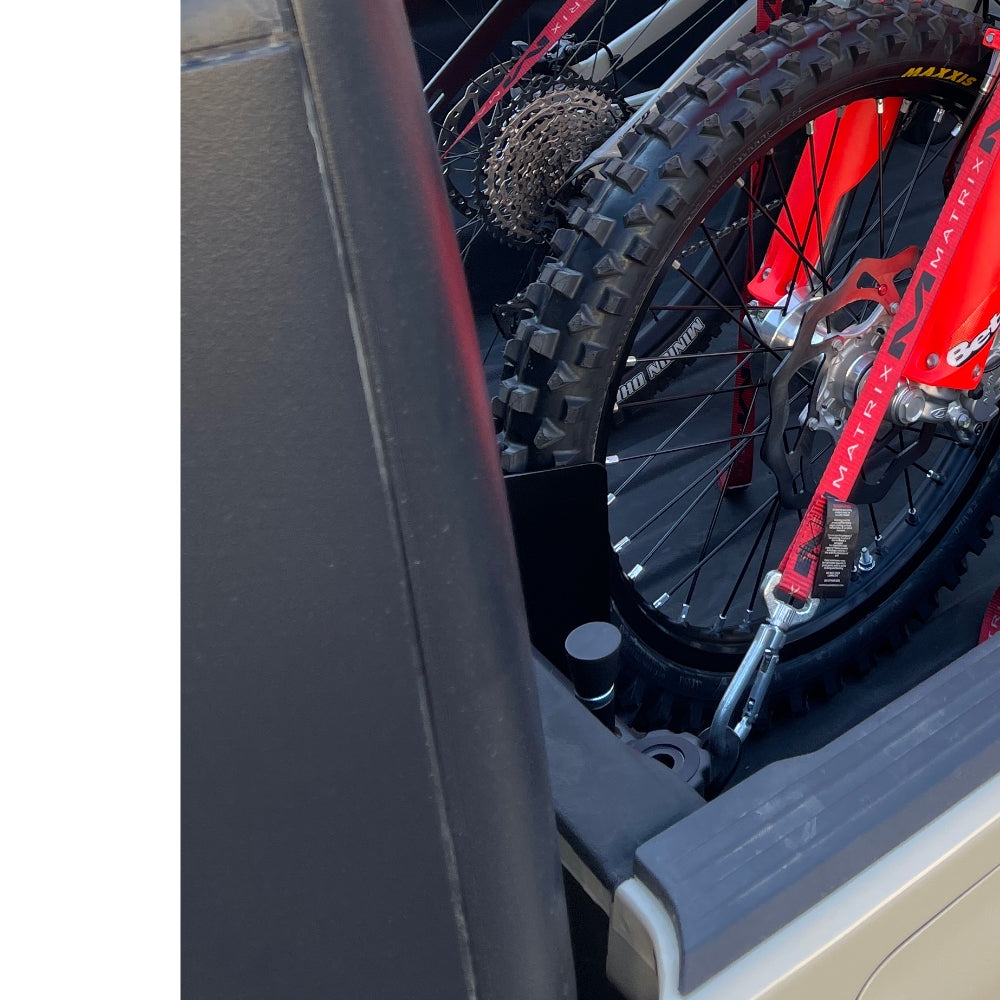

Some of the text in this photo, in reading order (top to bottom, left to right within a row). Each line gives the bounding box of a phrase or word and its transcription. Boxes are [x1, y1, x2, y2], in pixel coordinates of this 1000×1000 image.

[901, 66, 977, 87] MAXXIS
[929, 156, 984, 269] MATRIX
[646, 317, 705, 380] MINION
[831, 365, 892, 490] MATRIX
